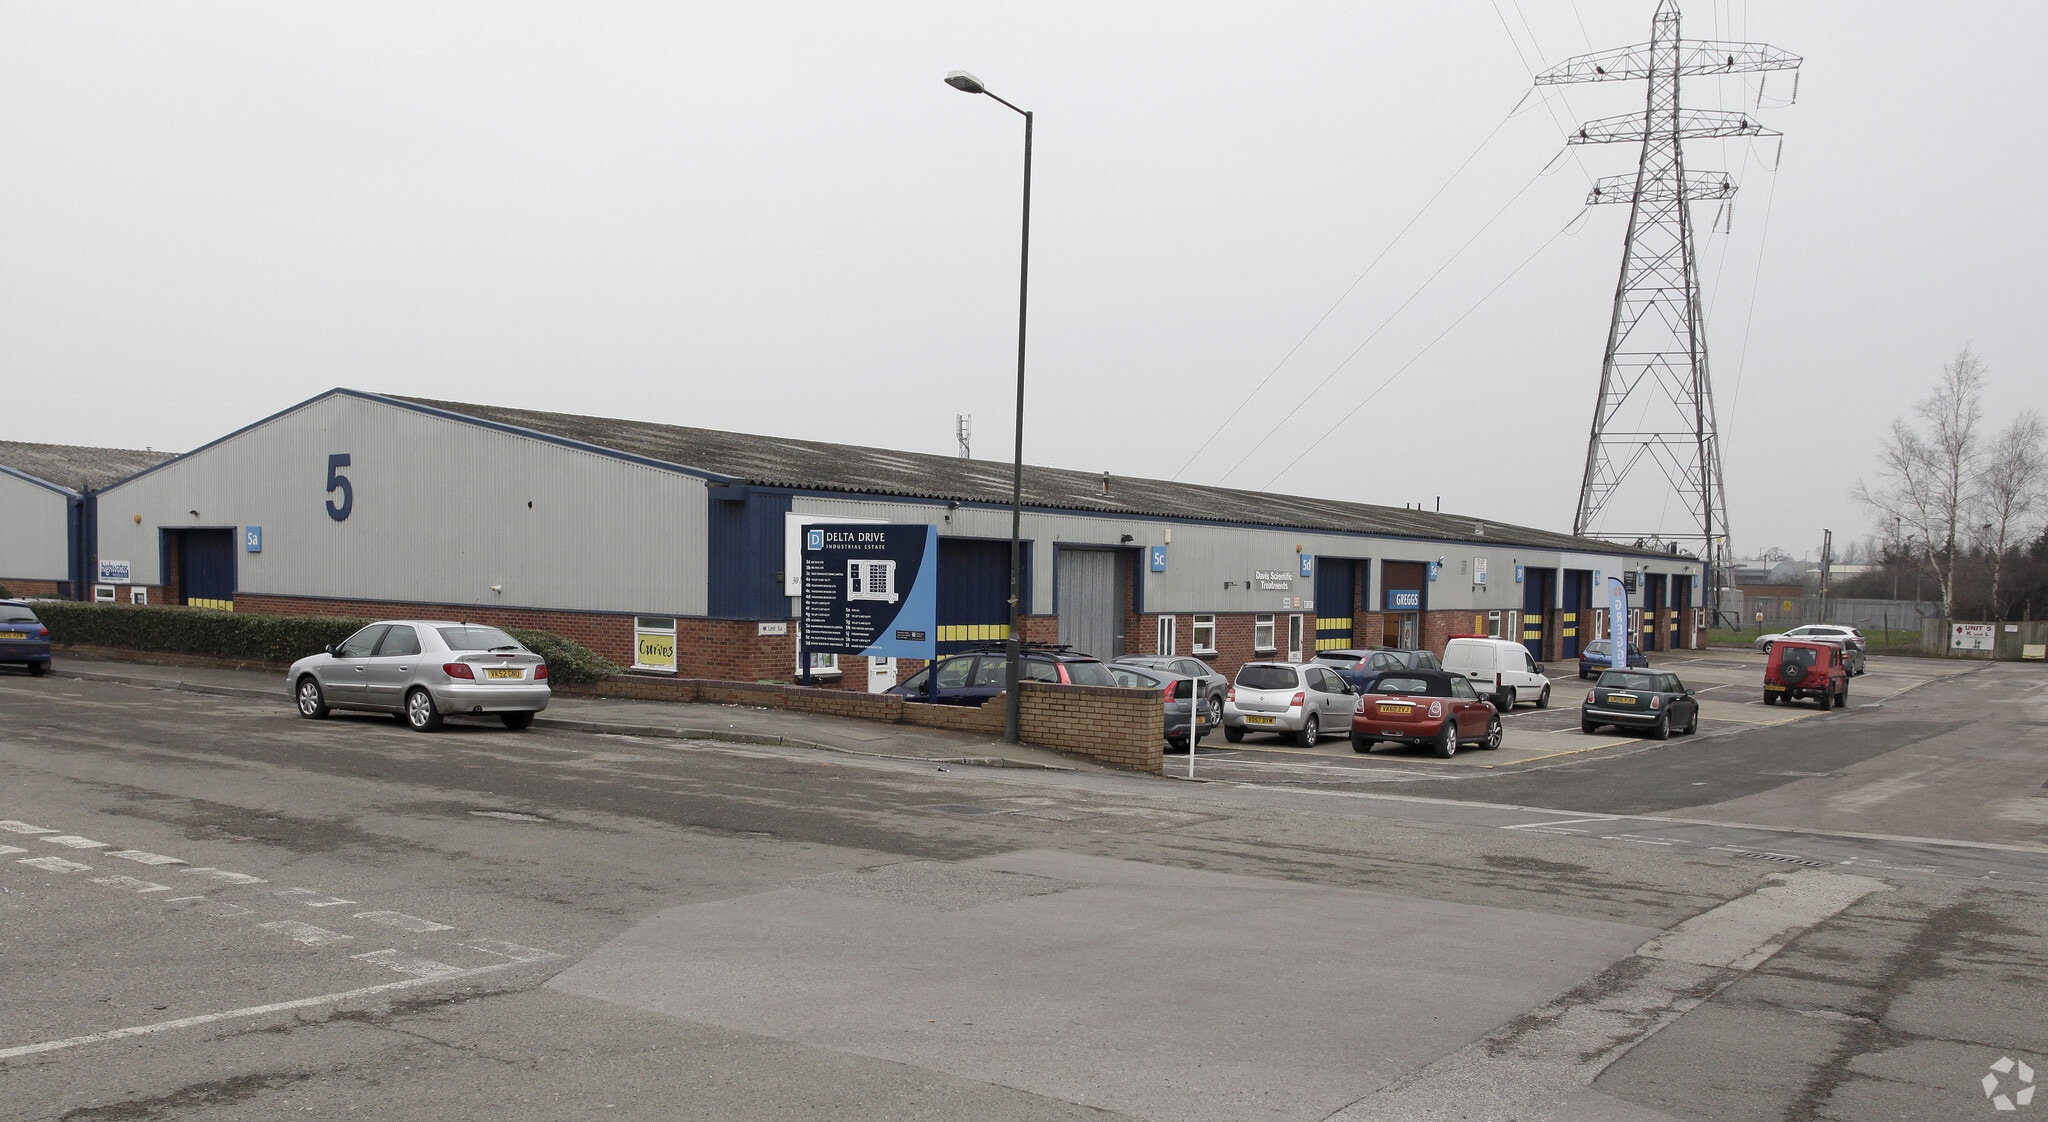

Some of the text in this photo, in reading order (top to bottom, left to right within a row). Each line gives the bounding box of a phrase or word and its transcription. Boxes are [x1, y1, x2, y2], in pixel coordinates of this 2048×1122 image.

[326, 453, 353, 522] 5
[247, 532, 258, 545] 5a
[812, 534, 820, 545] D
[826, 532, 885, 542] DELTA DRIVE
[1154, 552, 1165, 566] 5c
[1303, 559, 1311, 571] 5d
[101, 561, 129, 576] highwater
[1255, 571, 1293, 581] Davis Scientific
[1260, 580, 1289, 590] Treatments
[1396, 593, 1419, 606] GREGGS
[639, 639, 674, 658] Curves
